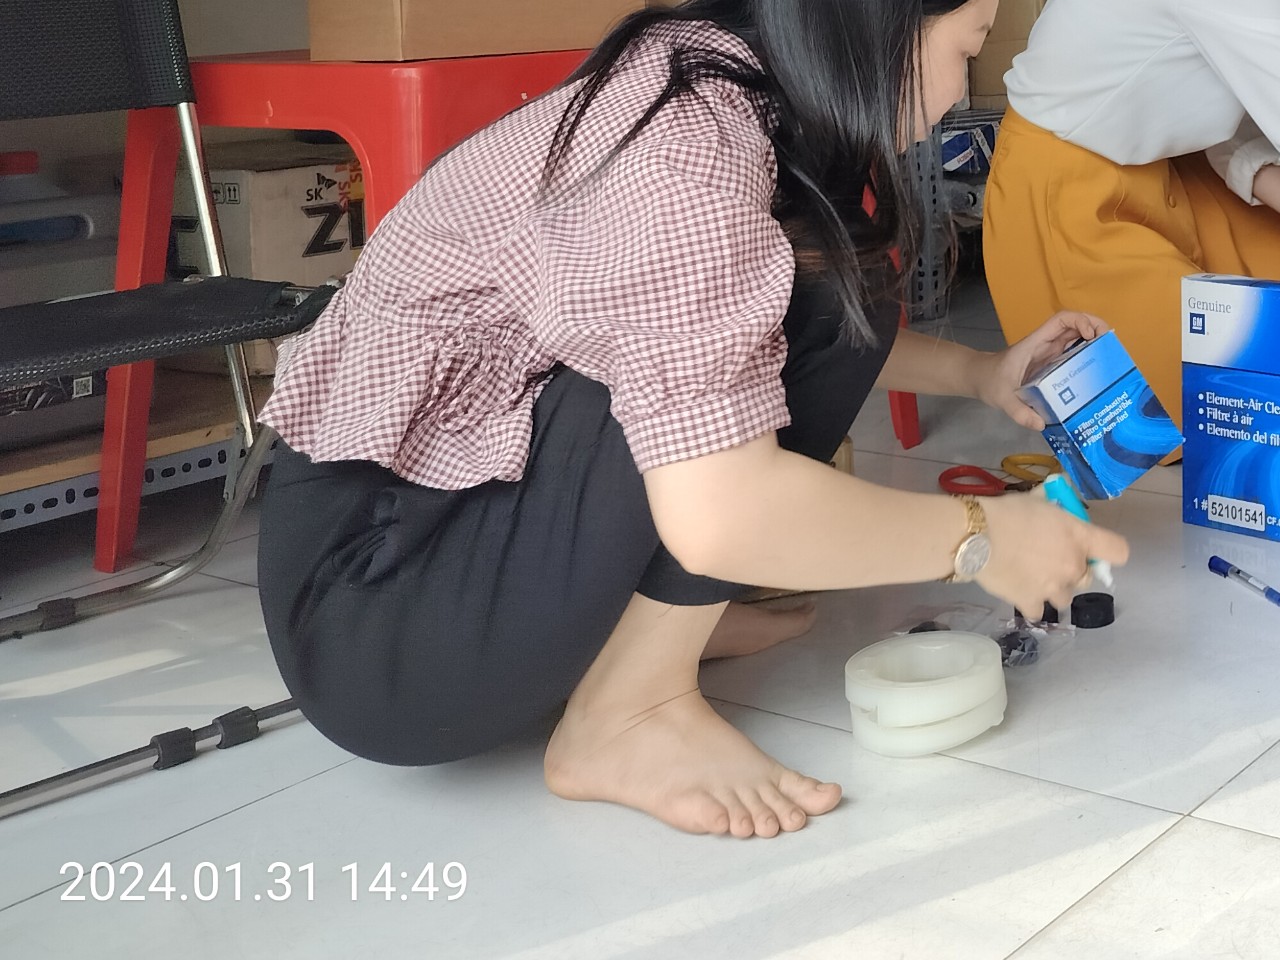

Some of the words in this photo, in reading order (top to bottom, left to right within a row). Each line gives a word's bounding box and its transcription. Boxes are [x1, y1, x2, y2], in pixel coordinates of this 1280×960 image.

[305, 187, 324, 203] SK
[301, 199, 366, 258] ZI
[1187, 296, 1232, 314] Genuine
[1206, 391, 1264, 411] Element-Air
[1077, 417, 1095, 433] Filtro
[1081, 423, 1099, 439] Filtro
[1098, 398, 1133, 427] Combustible
[1206, 406, 1231, 423] Filtre
[1241, 412, 1254, 426] air
[1087, 430, 1104, 446] Filter
[1206, 422, 1251, 441] Elemento
[1252, 431, 1268, 445] del
[1211, 502, 1265, 527] 52101541
